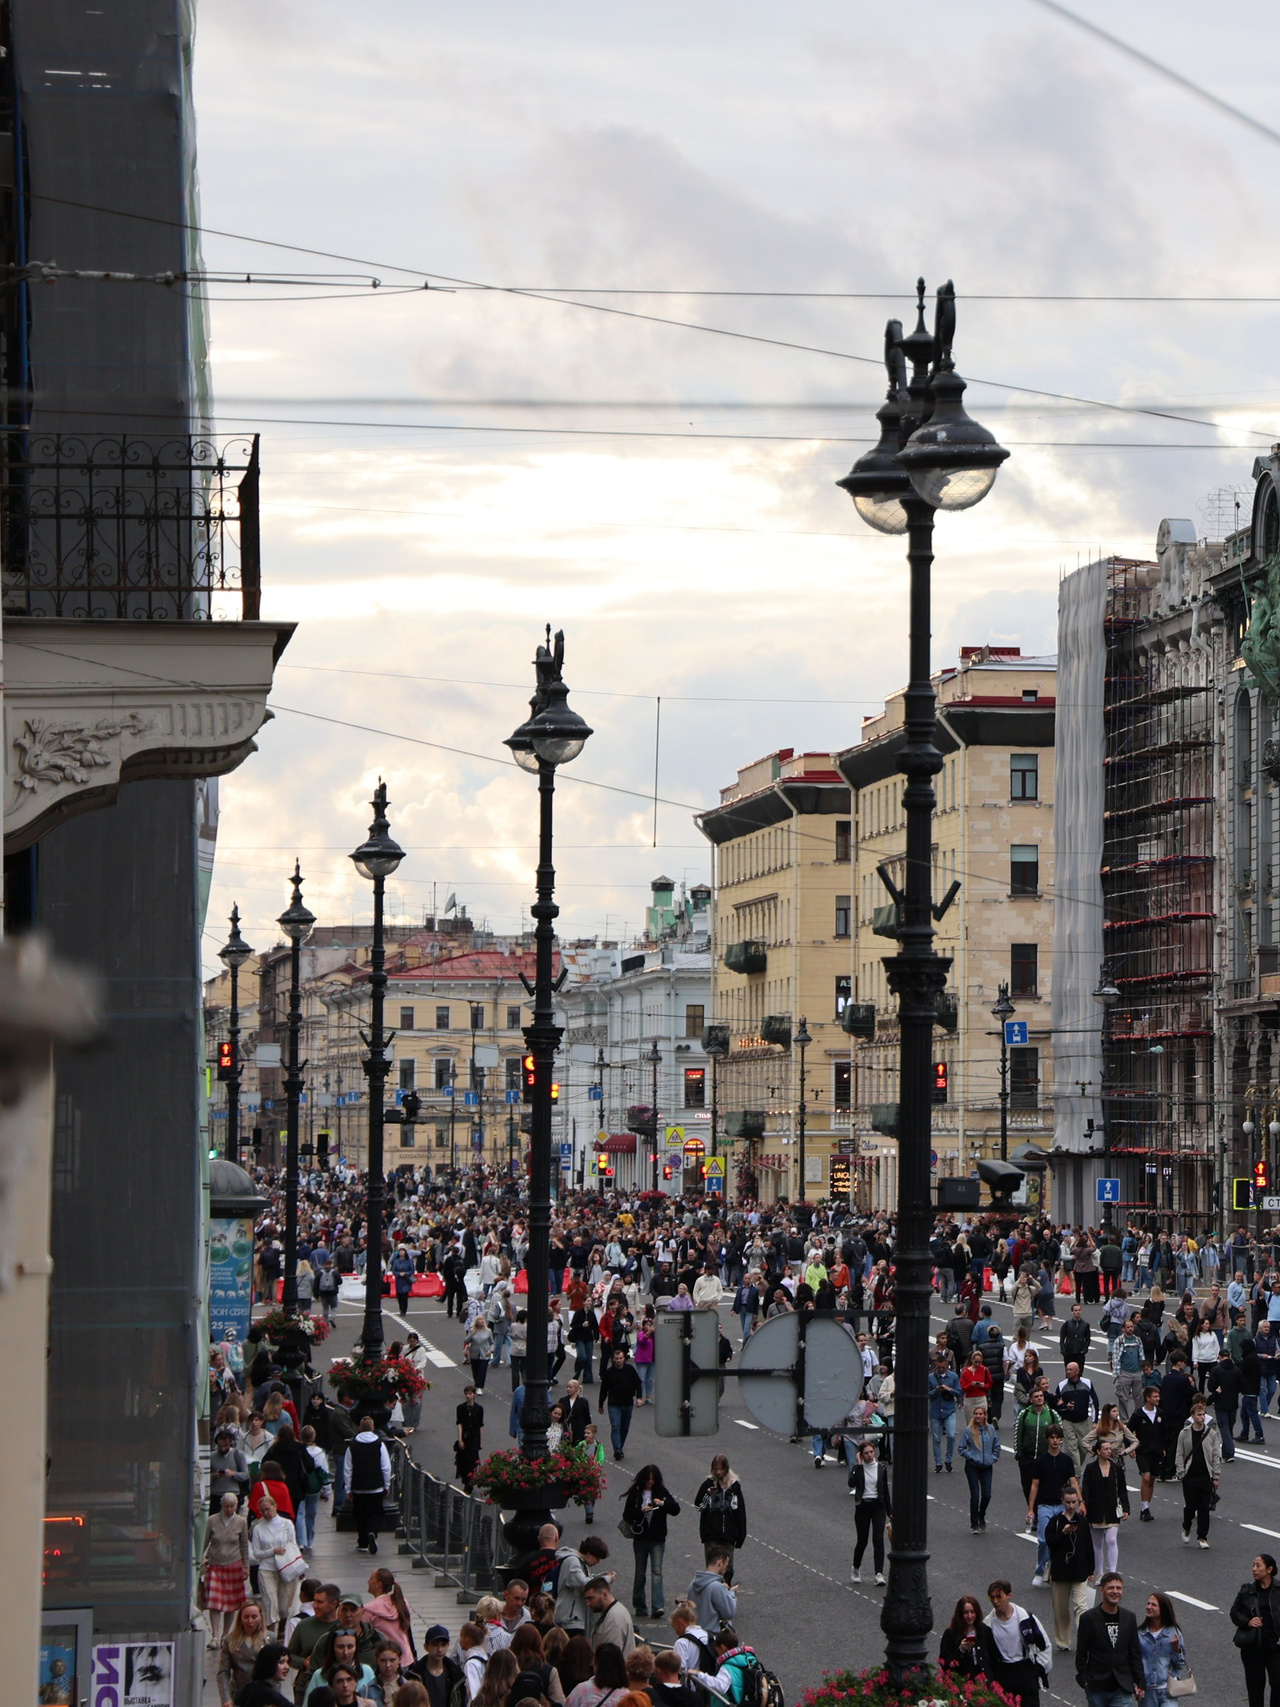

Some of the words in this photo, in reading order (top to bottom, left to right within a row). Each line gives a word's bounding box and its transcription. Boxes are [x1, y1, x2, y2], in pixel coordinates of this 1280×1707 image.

[1256, 1177, 1266, 1187] 35
[211, 1321, 223, 1330] 25
[124, 1696, 151, 1705] ВЫСТАВКА
